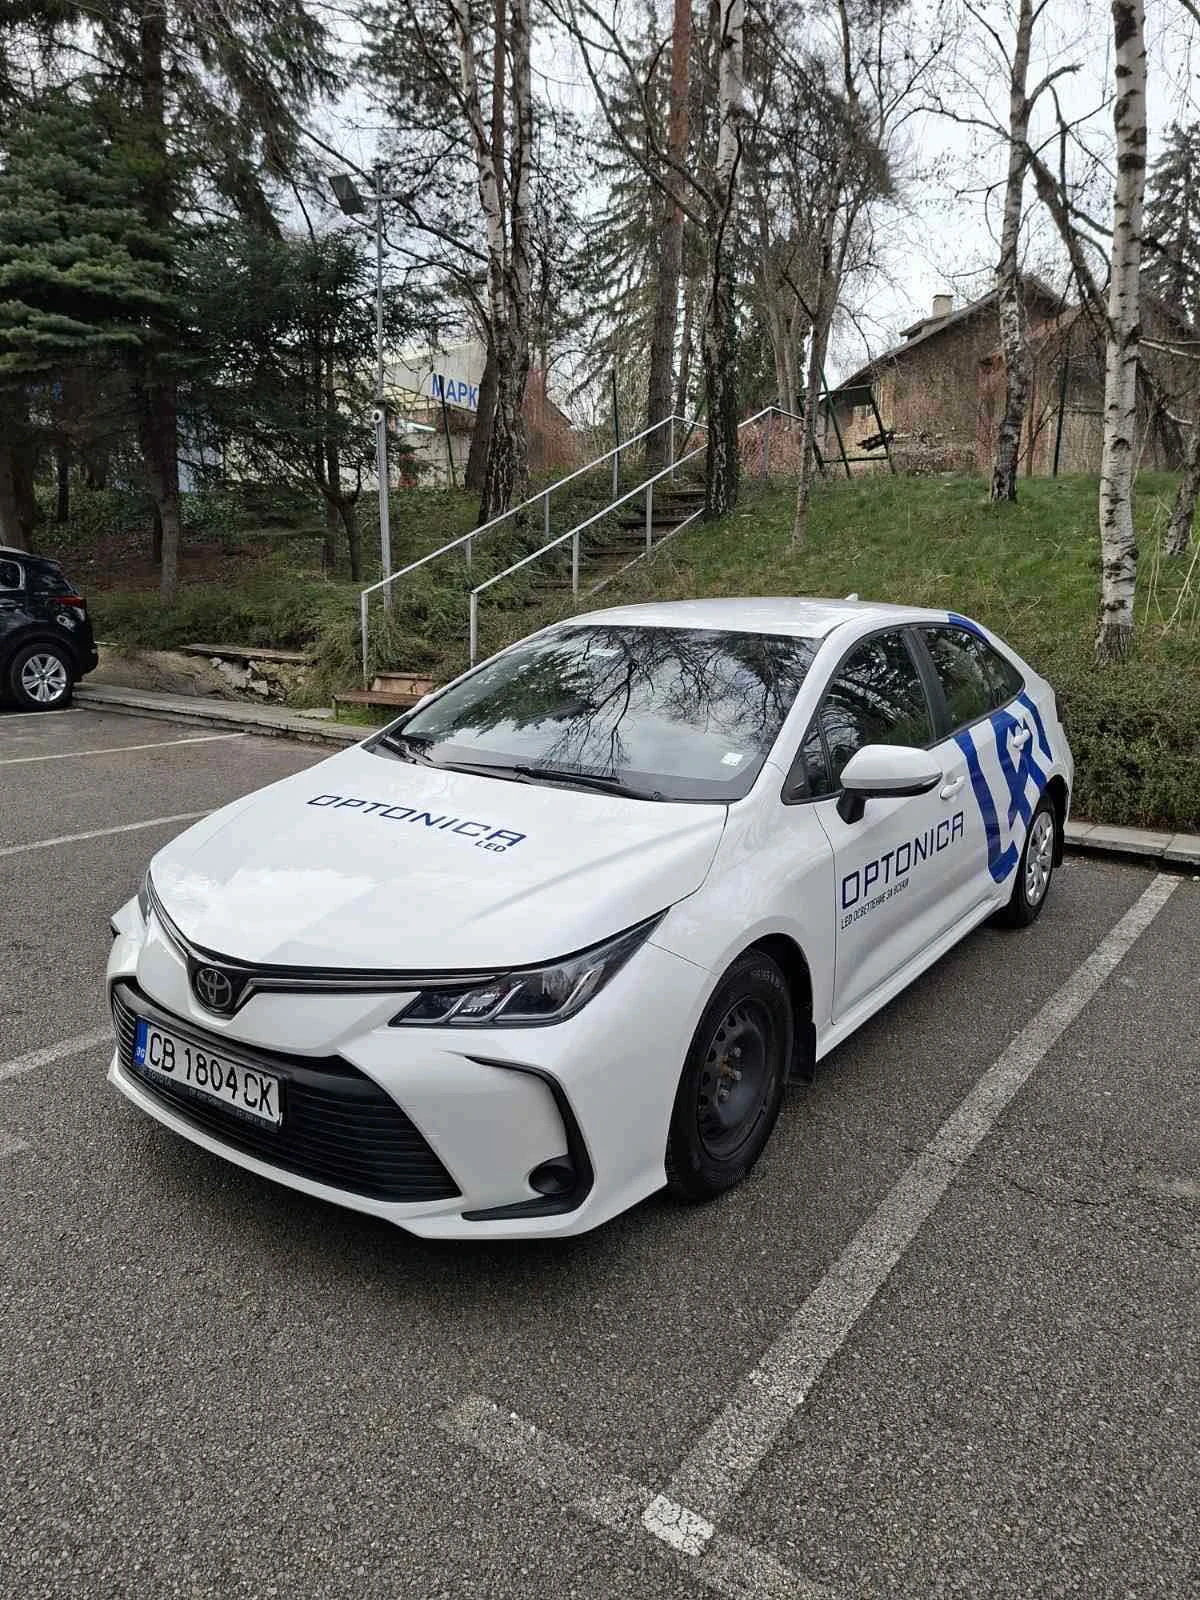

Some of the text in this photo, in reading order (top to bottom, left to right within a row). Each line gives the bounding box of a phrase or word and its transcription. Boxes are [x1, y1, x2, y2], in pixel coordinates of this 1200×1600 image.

[307, 794, 527, 847] OPTONICA
[474, 839, 507, 853] LED
[842, 810, 964, 910] OPTONICA
[841, 914, 852, 930] LED
[149, 1032, 175, 1072] CB
[184, 1047, 238, 1099] 1804
[243, 1072, 274, 1117] CK
